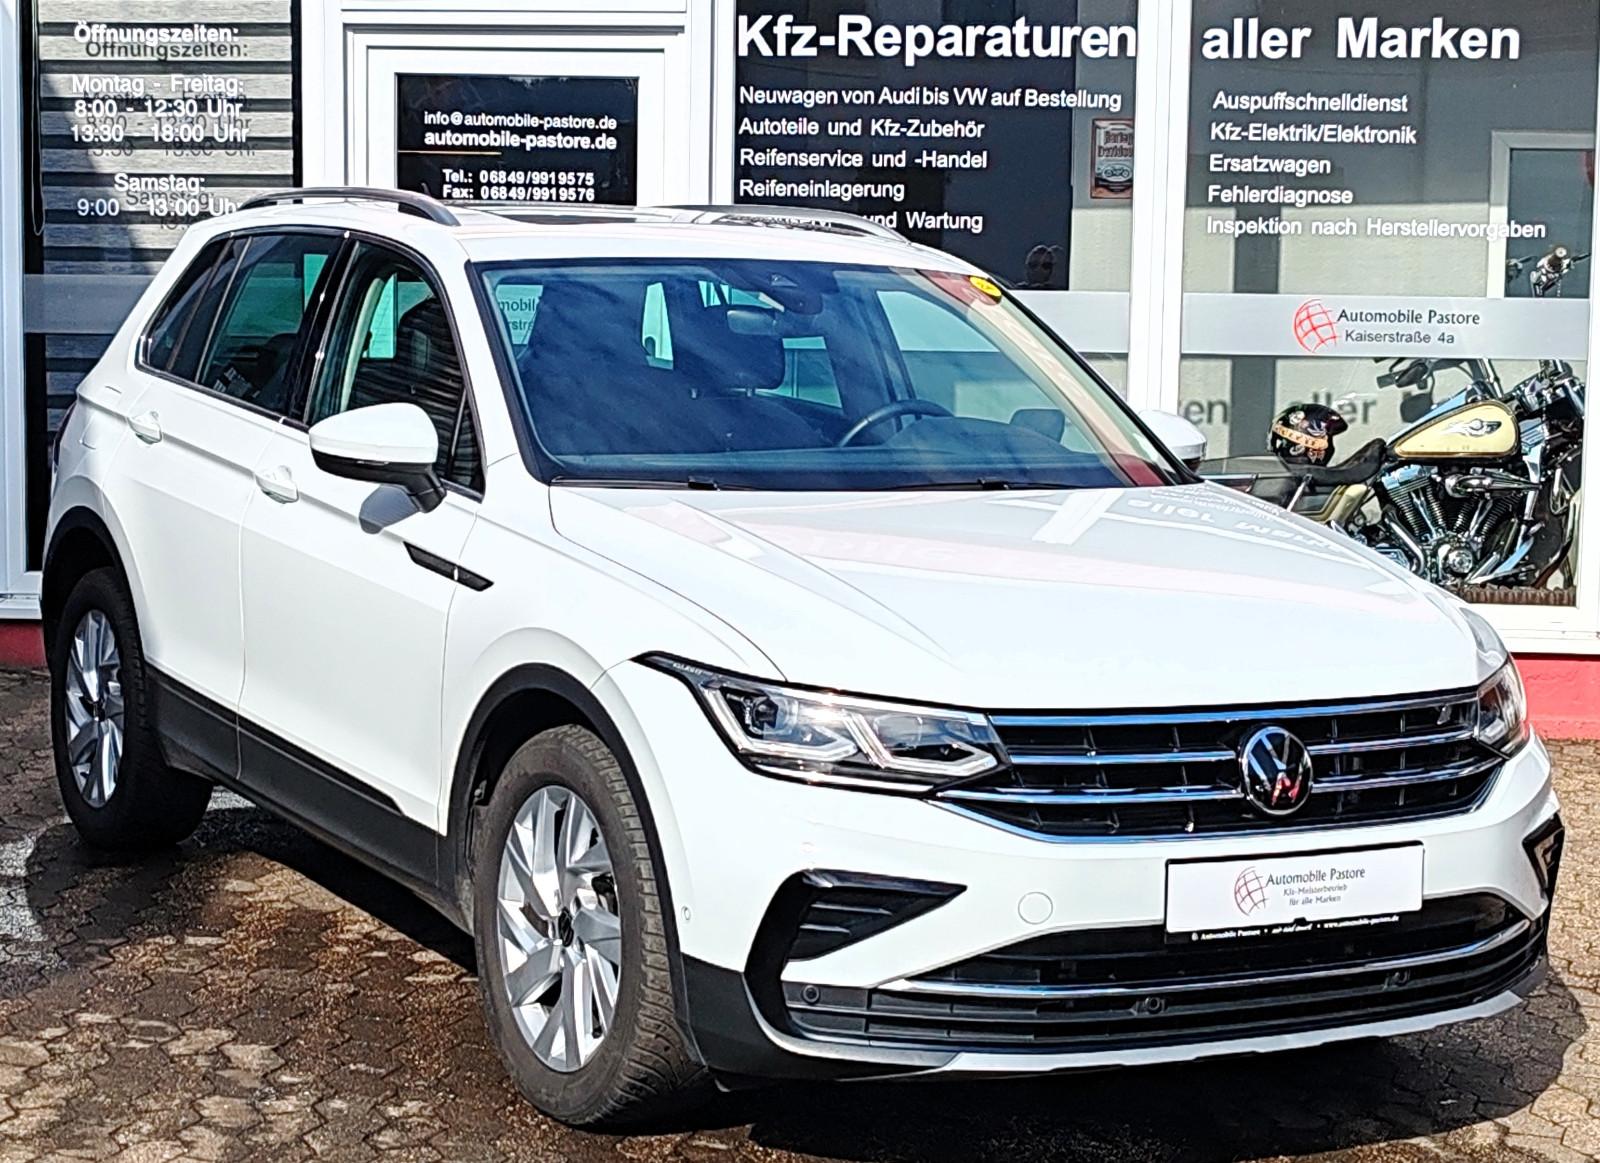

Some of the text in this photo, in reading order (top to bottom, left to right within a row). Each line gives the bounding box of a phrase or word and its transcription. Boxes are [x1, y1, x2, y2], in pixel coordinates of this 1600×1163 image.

[74, 20, 239, 46] Öffnungszeiten:
[737, 14, 1137, 66] Kfz-Reparaturen
[1201, 17, 1520, 60] aller Marken
[71, 74, 144, 96] Montag
[170, 74, 244, 97] Freitag:
[74, 100, 118, 118] 8:00
[145, 100, 198, 118] 12:30
[207, 100, 243, 118] Uhr
[739, 86, 1122, 111] Neuwagen von Audi bis VW auf Bestellung
[1213, 91, 1408, 113] Auspuffschnelldienst
[424, 111, 617, 130] info@automobile-pastore.de
[739, 119, 986, 138] Autoteile und Kfz-Zubehör
[71, 125, 124, 143] 13:30
[151, 125, 204, 143] 18:00
[213, 125, 249, 142] Uhr
[424, 131, 617, 150] automobile-pastore.de
[1210, 123, 1417, 145] Kfz-Elektrik/Elektronik
[740, 149, 987, 169] Reifenservice und -Handel
[1209, 154, 1332, 176] Ersatzwagen
[114, 173, 205, 194] Samstag:
[443, 169, 594, 185] Tel.: 06849/9919575
[443, 185, 595, 201] Fax: 06849/9919576
[740, 179, 905, 201] Reifeneinlagerung
[1208, 185, 1354, 206] Fehlerdiagnose
[77, 199, 120, 216] 9:00
[149, 198, 200, 216] 13:00
[906, 211, 983, 233] Wartung
[1207, 216, 1546, 240] Inspektion nach Herstellervorgaben
[1337, 308, 1480, 326] Automobile Pastore
[1344, 329, 1455, 345] Kaiserstraße 4a
[1266, 867, 1366, 887] Automobile Pastore
